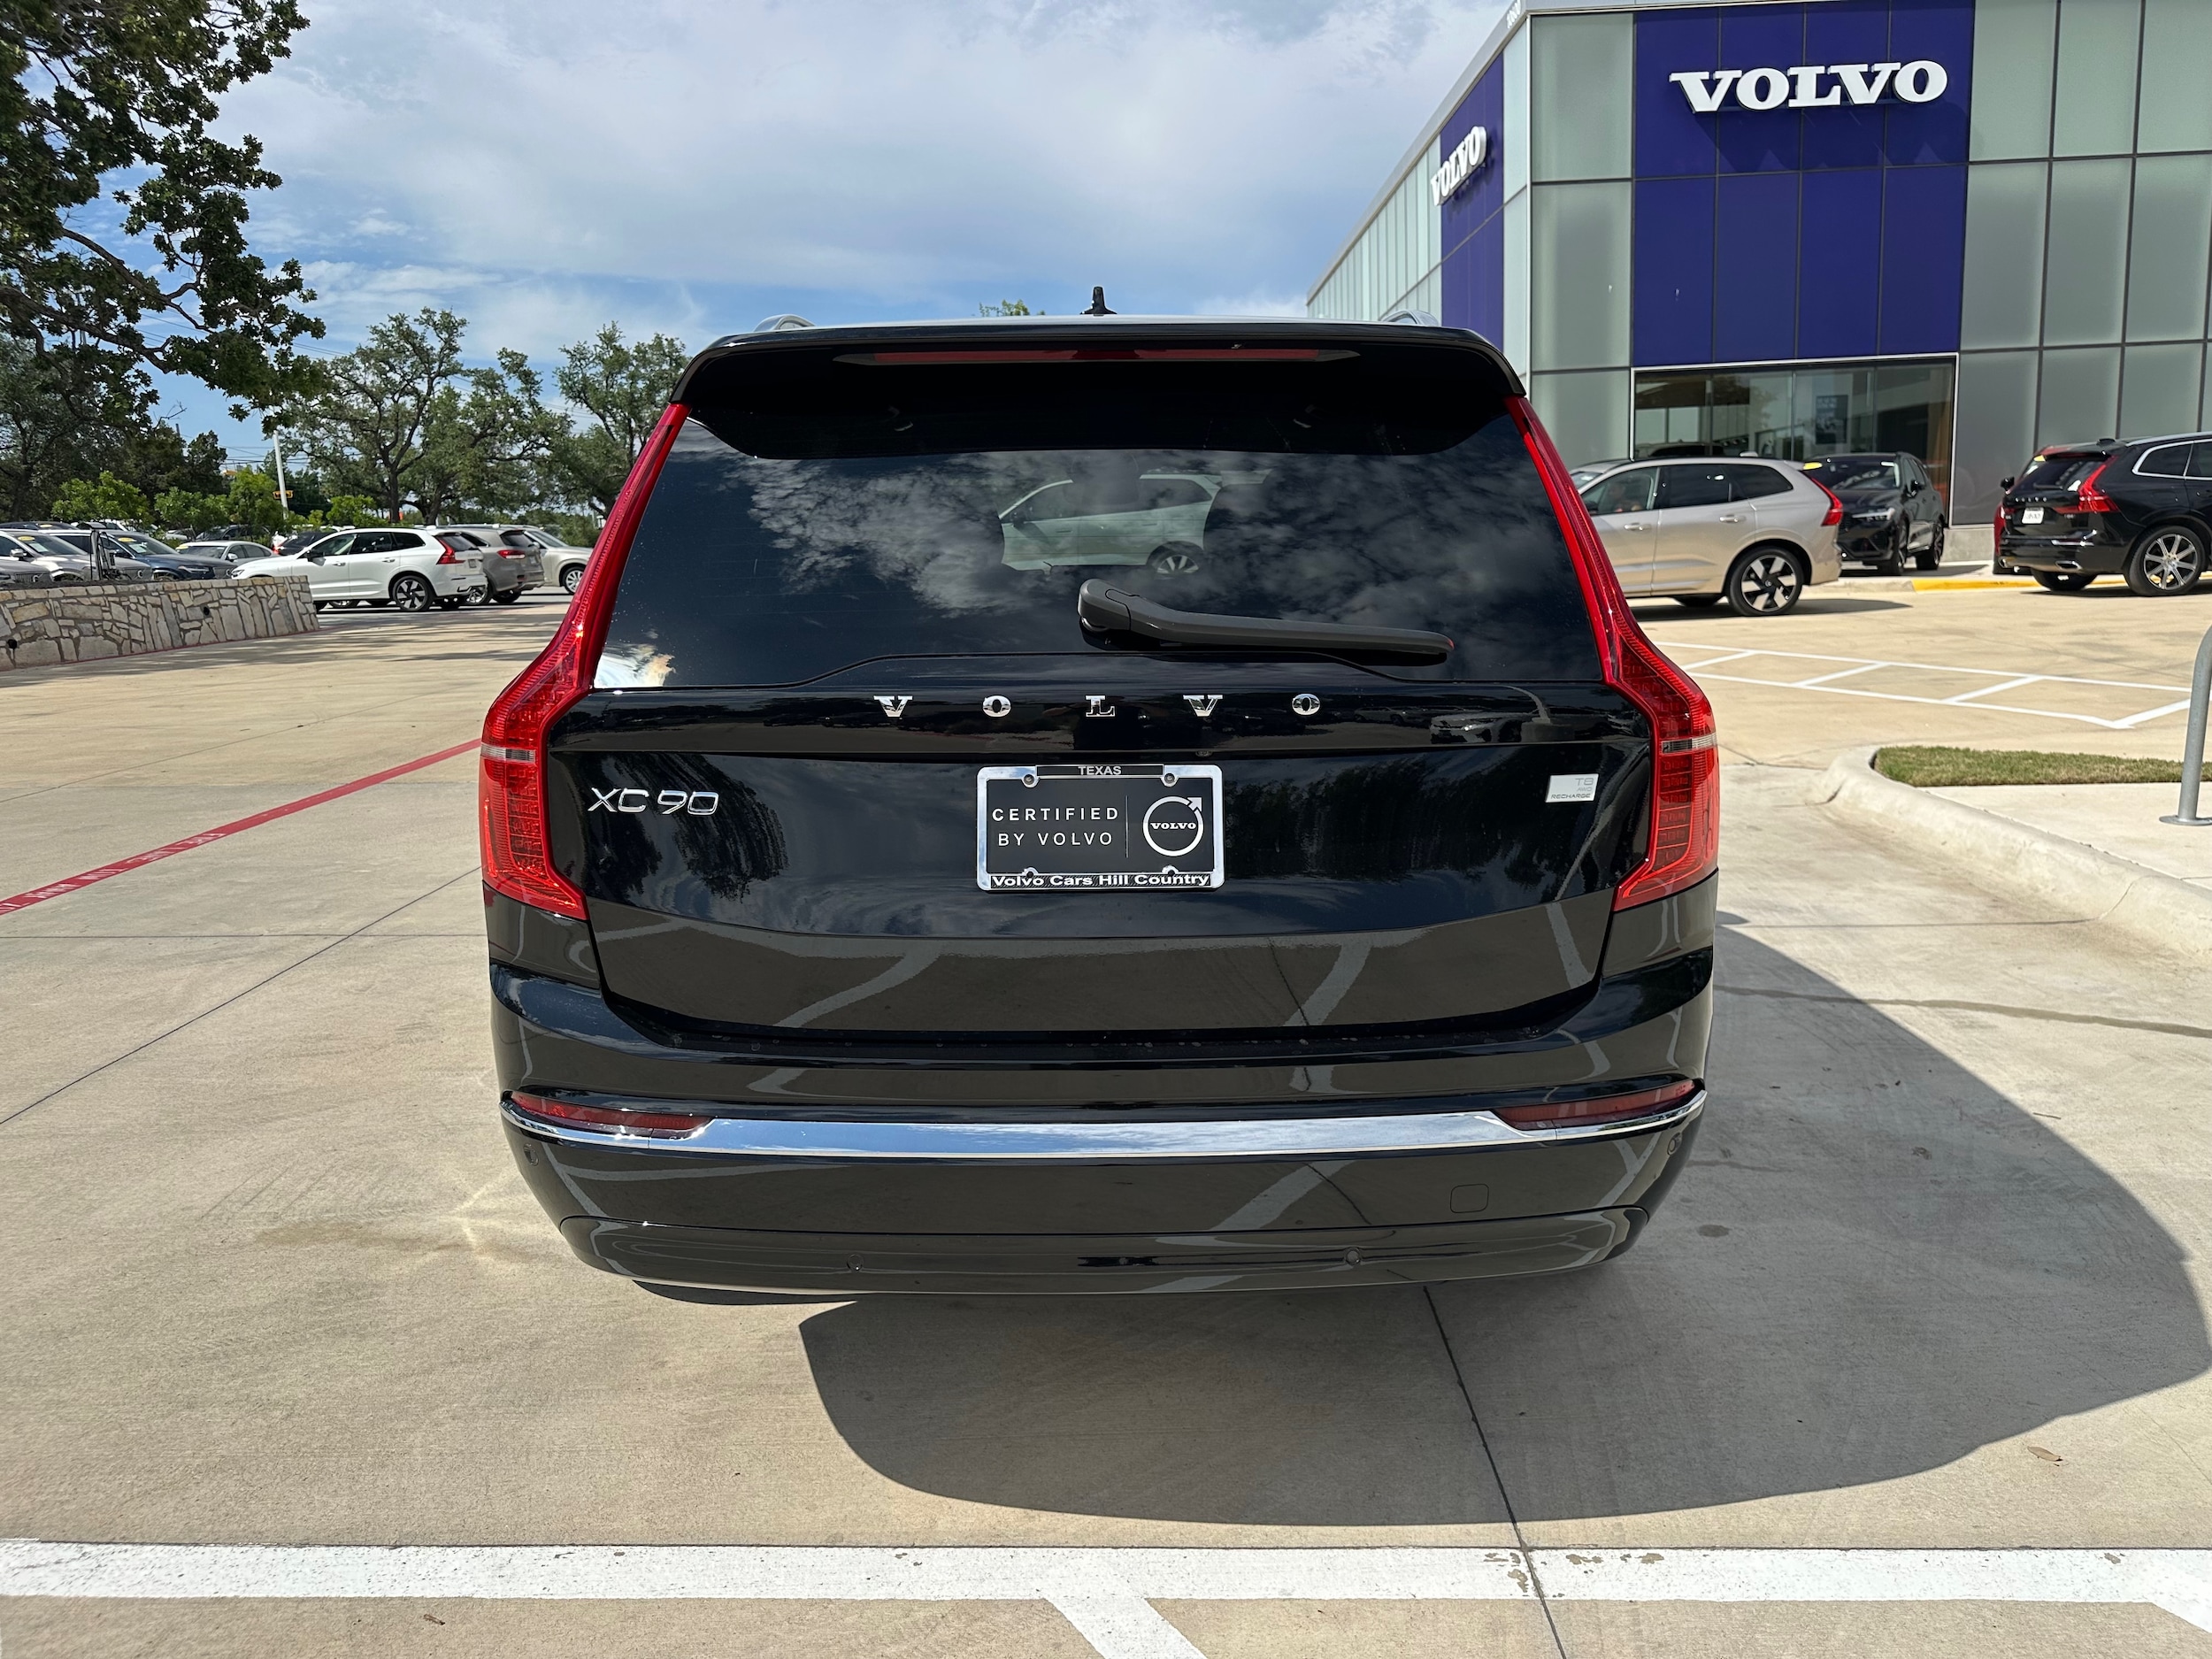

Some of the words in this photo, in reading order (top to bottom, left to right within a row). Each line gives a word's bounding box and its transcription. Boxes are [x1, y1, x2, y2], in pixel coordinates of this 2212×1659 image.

[1668, 59, 1948, 113] VOLVO
[1430, 126, 1487, 207] VOLVO
[872, 692, 1321, 718] VOLVO
[1077, 764, 1122, 776] TEXAS
[1575, 777, 1594, 787] T8
[991, 807, 1119, 821] CERTIFIED
[1150, 821, 1196, 830] VOLVO
[997, 833, 1025, 847] BY
[1037, 832, 1113, 846] VOLVO
[992, 875, 1044, 887] Volvo
[1049, 875, 1094, 886] Cars
[1099, 874, 1129, 886] Hill
[1133, 873, 1210, 887] Country
